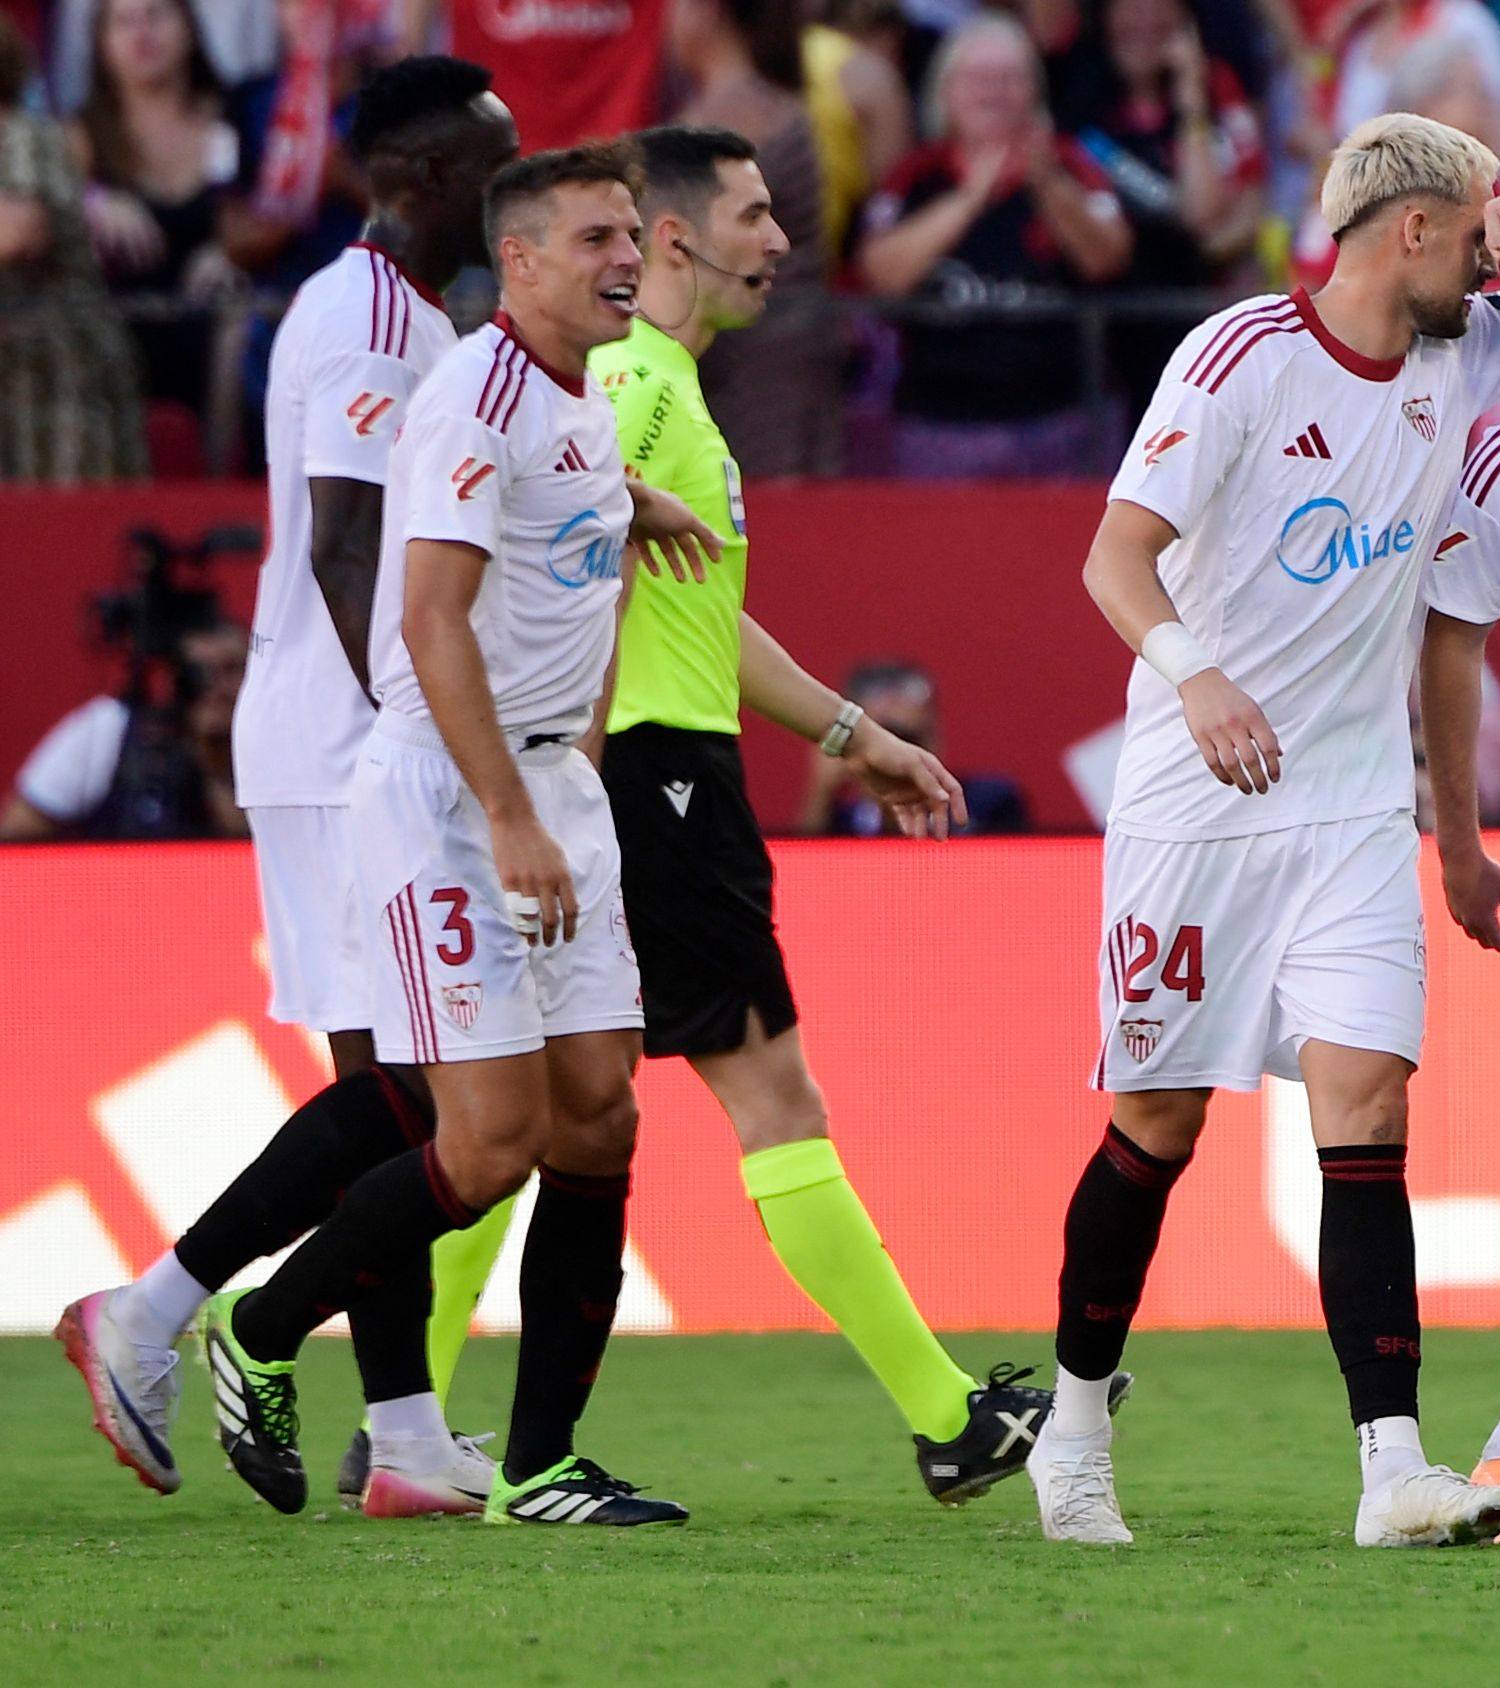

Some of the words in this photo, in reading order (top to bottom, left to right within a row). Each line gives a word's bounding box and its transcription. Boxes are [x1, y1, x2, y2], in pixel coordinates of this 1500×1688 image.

[1275, 496, 1424, 584] Mide
[429, 886, 475, 967] 3
[1123, 921, 1206, 1003] 24
